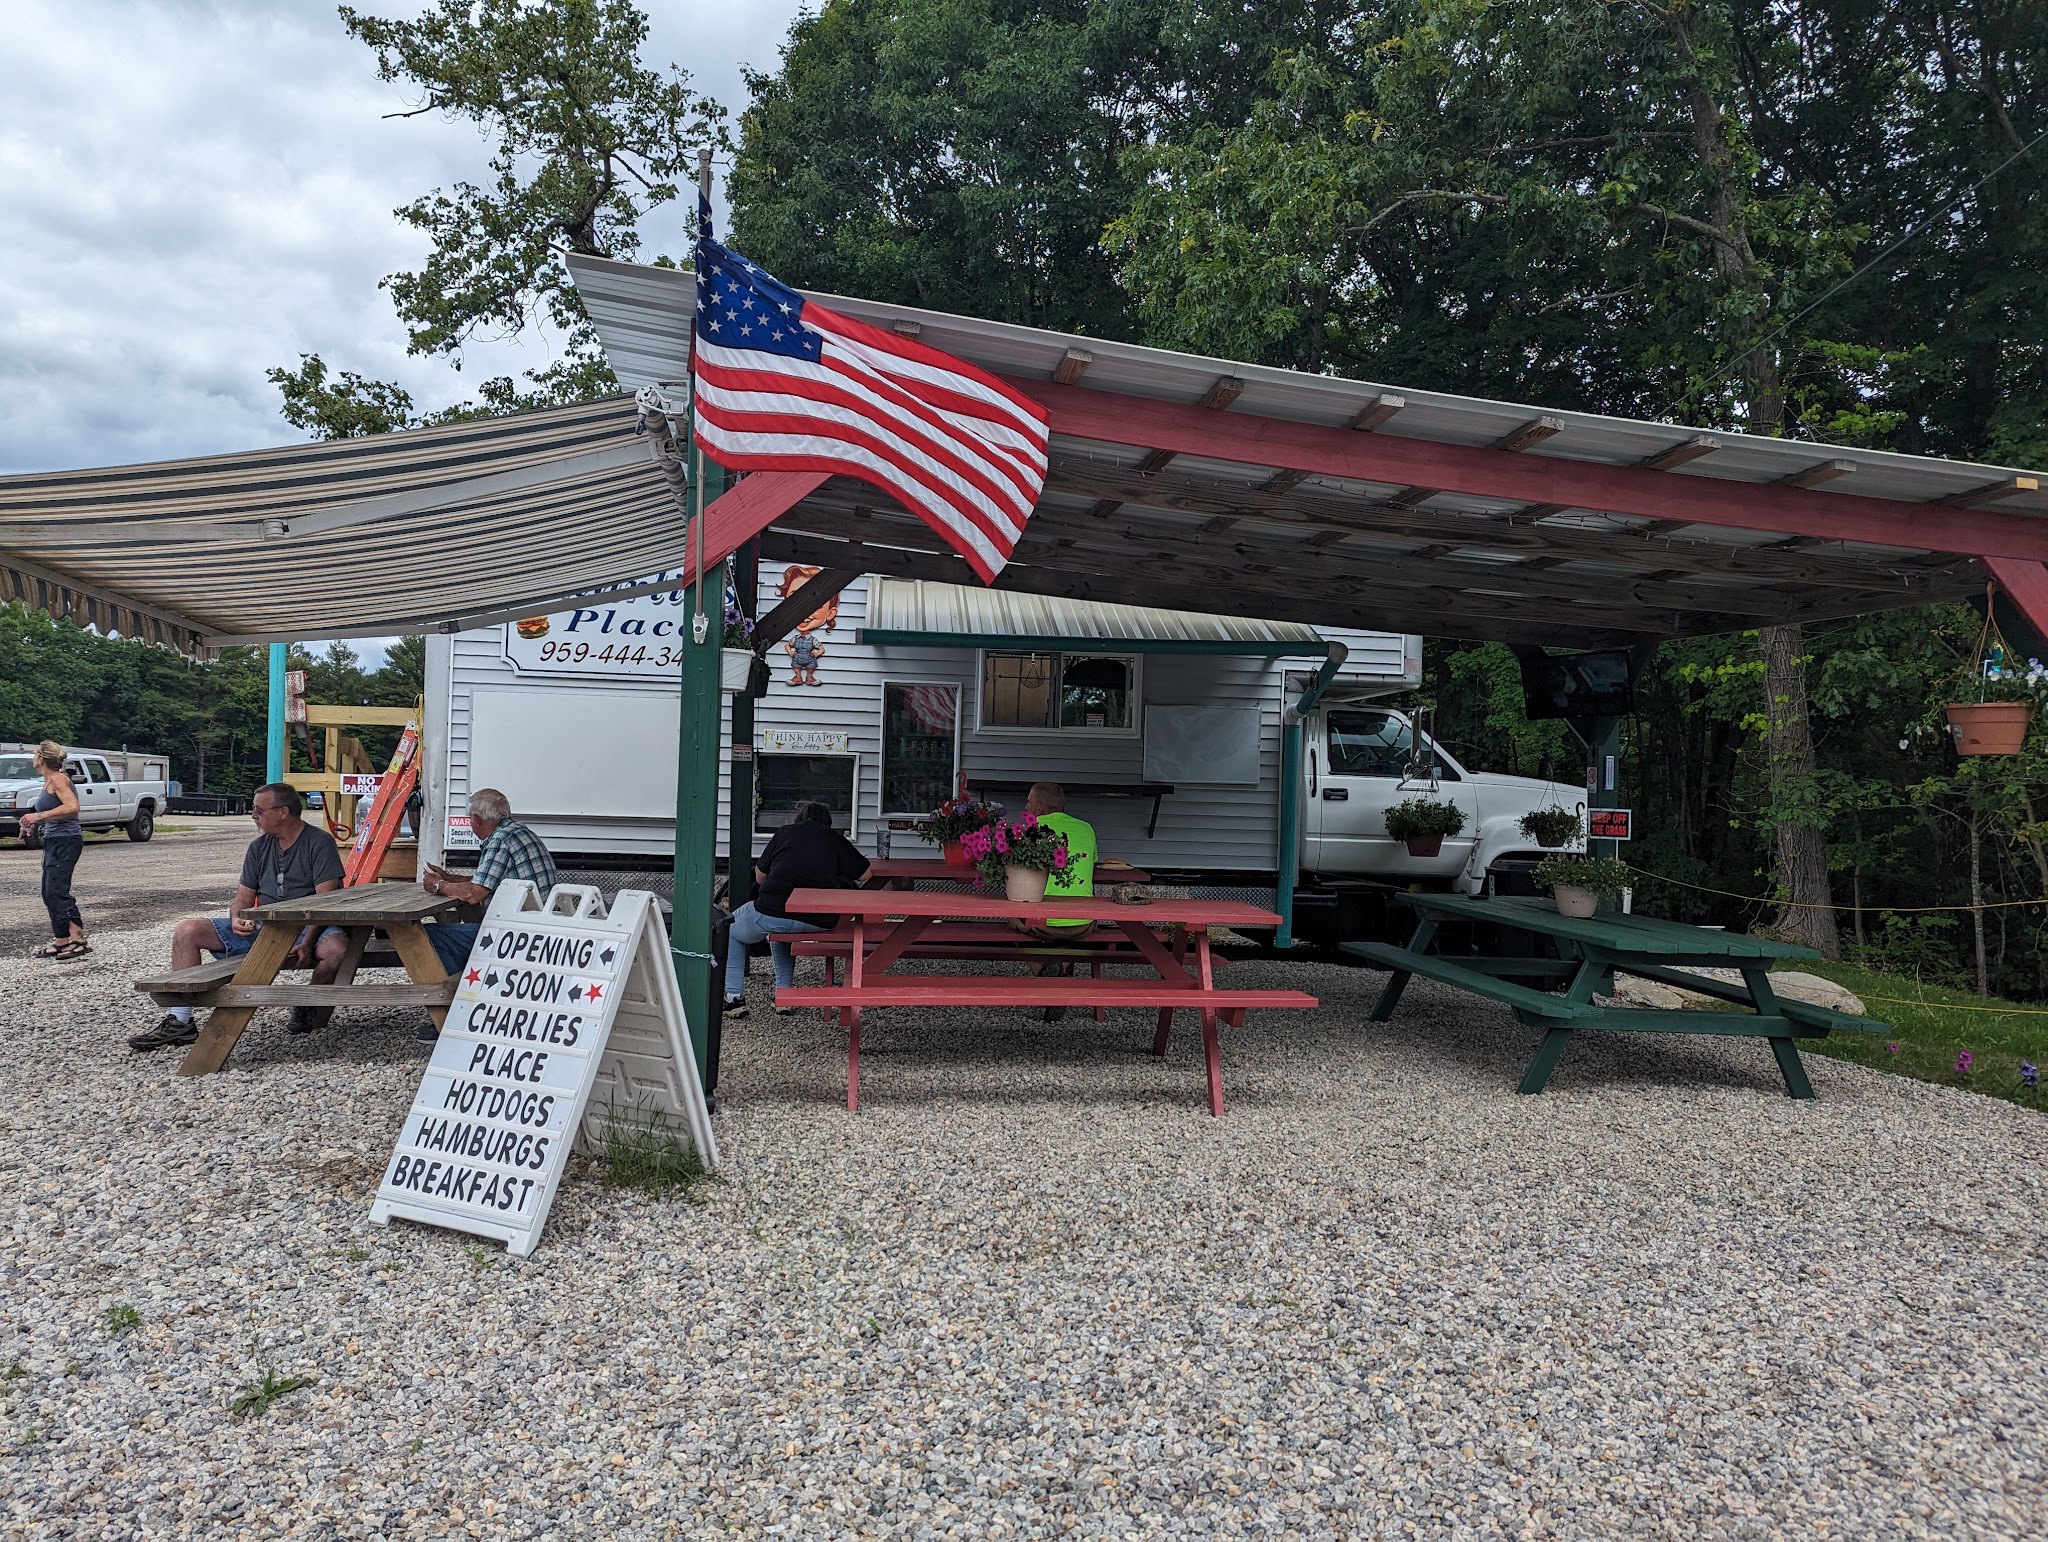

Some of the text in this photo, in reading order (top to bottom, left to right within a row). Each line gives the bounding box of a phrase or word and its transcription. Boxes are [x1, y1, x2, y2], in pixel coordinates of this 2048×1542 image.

[540, 640, 683, 668] 959-444-34
[769, 733, 842, 743] THINK HAPPY
[344, 784, 382, 794] PARKIN
[357, 776, 376, 785] NO
[1591, 812, 1627, 824] KEEP OFF
[1592, 824, 1627, 836] THE GRASS
[450, 837, 473, 845] Cameras
[451, 828, 474, 838] Security
[497, 931, 593, 968] OPENING
[500, 968, 564, 1003] SOON
[467, 1002, 582, 1046] CHARLIES
[468, 1043, 548, 1082] PLACE
[443, 1079, 554, 1127] HOTDOGS
[414, 1116, 549, 1169] HAMBURGS
[391, 1155, 534, 1212] BREAKFAST
